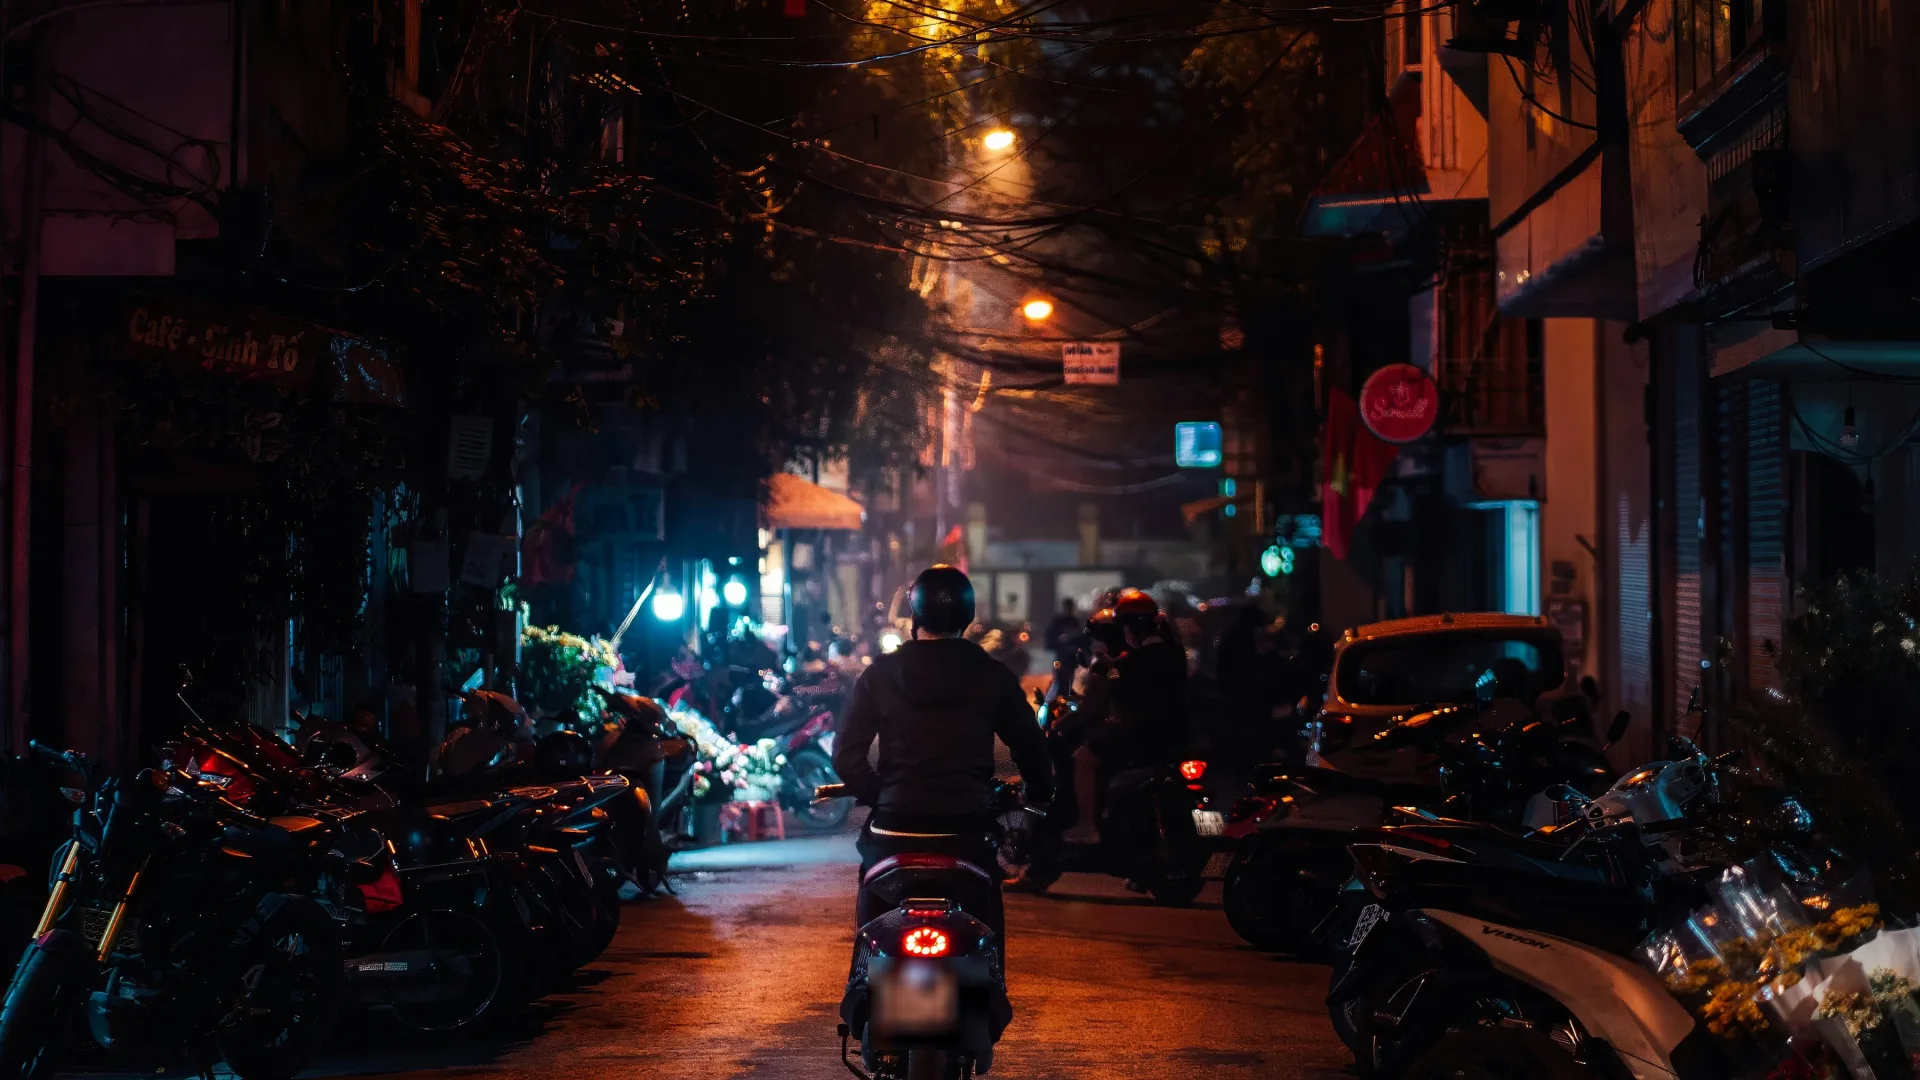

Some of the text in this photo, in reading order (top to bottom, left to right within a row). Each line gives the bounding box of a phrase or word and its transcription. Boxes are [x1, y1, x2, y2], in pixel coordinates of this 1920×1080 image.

[202, 324, 260, 367] Sinh
[267, 330, 305, 372] Tố
[1482, 925, 1550, 949] VISION
